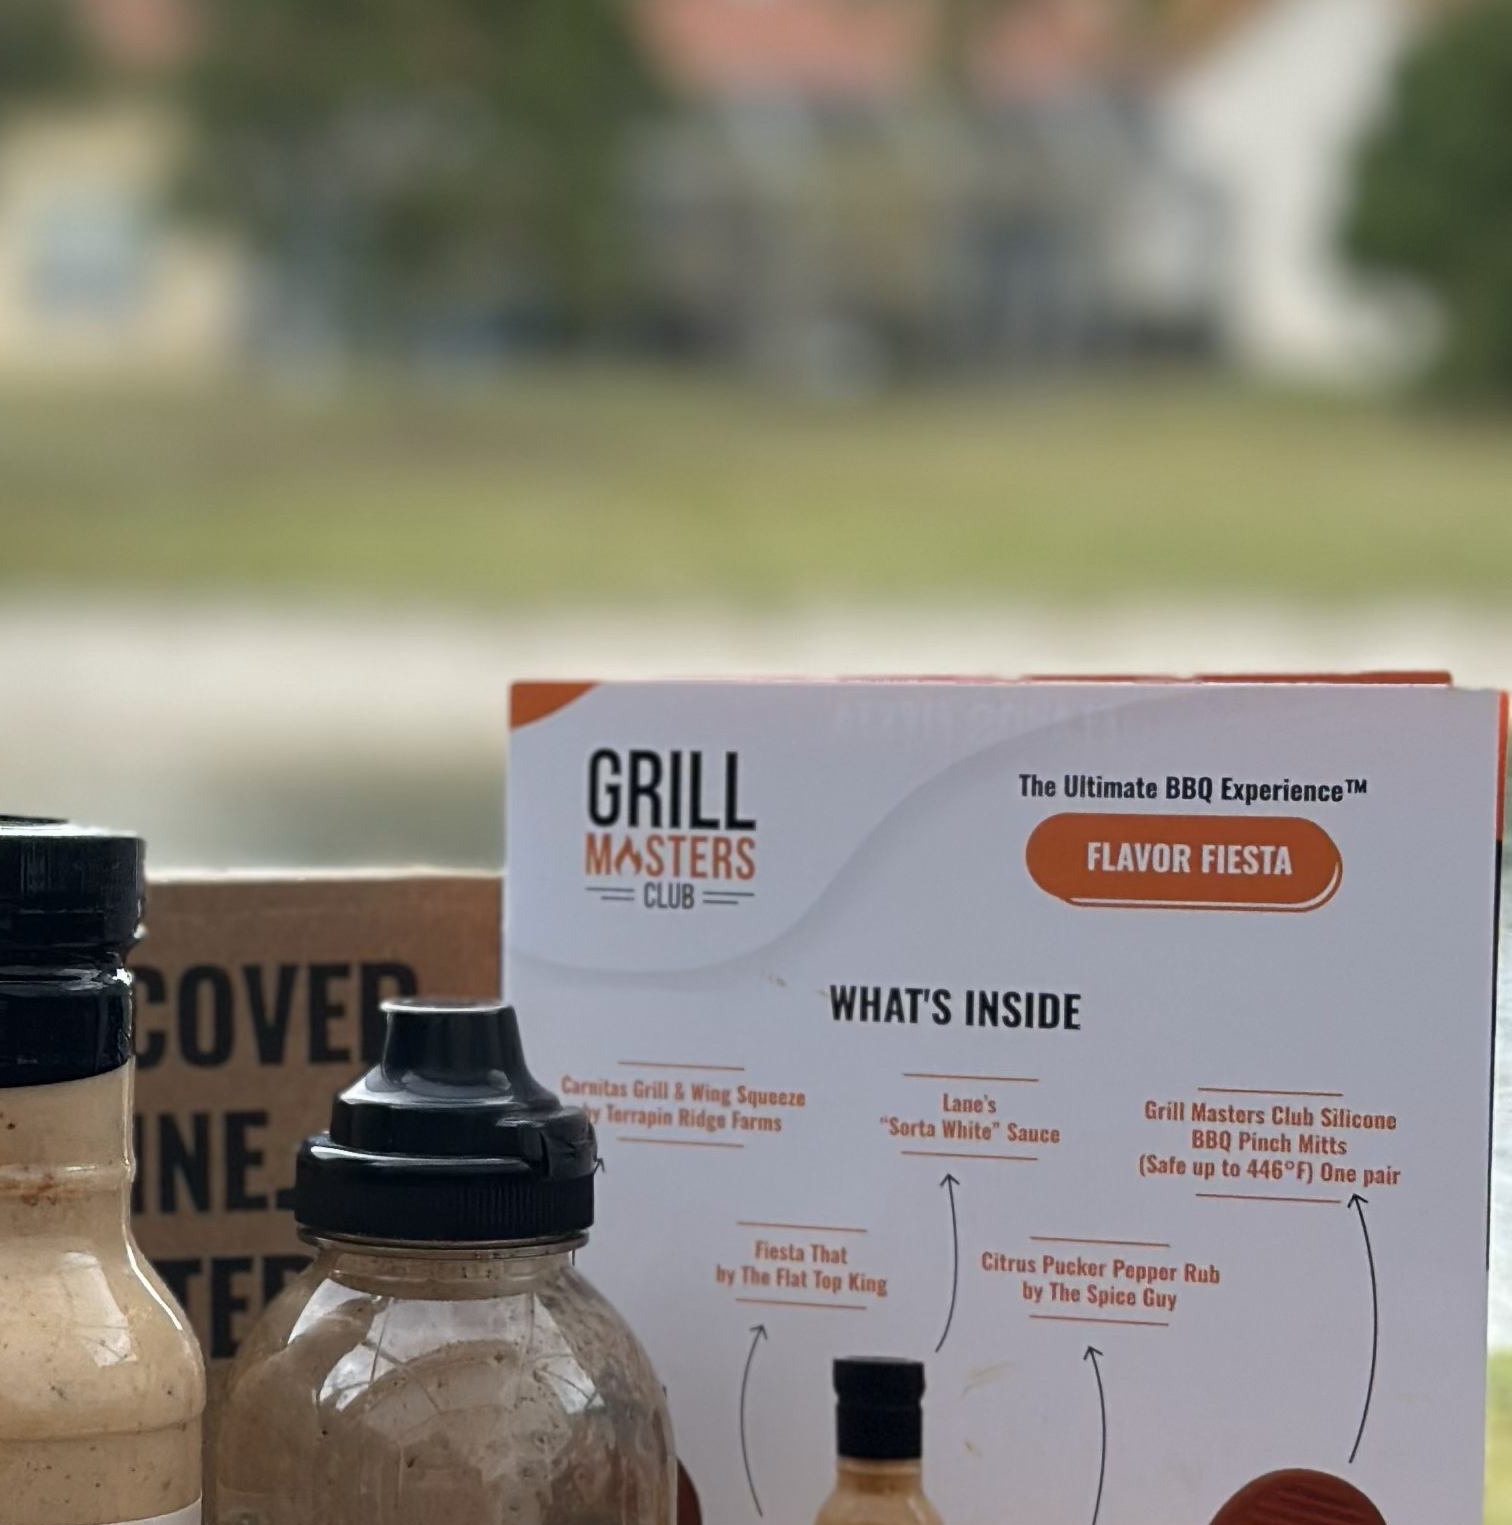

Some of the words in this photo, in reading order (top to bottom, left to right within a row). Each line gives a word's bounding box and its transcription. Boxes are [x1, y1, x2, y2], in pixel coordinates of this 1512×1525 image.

[587, 748, 757, 831] GRILL
[1019, 773, 1056, 797] The
[1064, 774, 1158, 799] Ultimate
[1166, 777, 1213, 803] BBQ
[585, 832, 757, 880] MASTERS
[1088, 841, 1191, 873] FLAVOR
[1202, 844, 1292, 874] FIESTA
[643, 882, 696, 909] CLUB
[830, 984, 952, 1026] WHAT'S
[966, 989, 1081, 1031] INSIDE
[561, 1075, 628, 1100] Carnitas
[633, 1079, 668, 1101] Grill
[674, 1081, 685, 1100] &
[691, 1081, 731, 1106] Wing
[736, 1086, 806, 1110] Squeeze
[943, 1092, 996, 1114] Lane's
[606, 1104, 673, 1129] Terrapin
[679, 1109, 726, 1134] Ridge
[732, 1112, 783, 1133] Farms
[1144, 1101, 1185, 1122] Grill
[1192, 1103, 1265, 1126] Masters
[1271, 1106, 1314, 1127] Club
[1320, 1107, 1397, 1131] Silicone
[1007, 1123, 1061, 1144] Sauce
[1192, 1130, 1232, 1153] BBQ
[1238, 1131, 1292, 1154] Pinch
[1298, 1133, 1348, 1156] Mitts
[1139, 1154, 1186, 1177] (Safe
[1192, 1160, 1216, 1181] up
[1222, 1159, 1241, 1177] to
[1320, 1162, 1357, 1184] One
[1363, 1166, 1401, 1188] pair
[755, 1240, 805, 1262] Fiesta
[810, 1243, 848, 1265] That
[981, 1250, 1036, 1274] Citrus
[1043, 1255, 1106, 1277] Pucker
[1113, 1258, 1177, 1284] Pepper
[1184, 1261, 1220, 1284] Rub
[716, 1264, 735, 1286] by
[742, 1266, 771, 1286] The
[776, 1268, 808, 1289] Flat
[813, 1270, 842, 1293] Top
[849, 1272, 887, 1297] King
[1022, 1280, 1043, 1302] by
[1049, 1282, 1081, 1303] The
[1087, 1284, 1136, 1308] Spice
[1143, 1286, 1177, 1311] Guy
